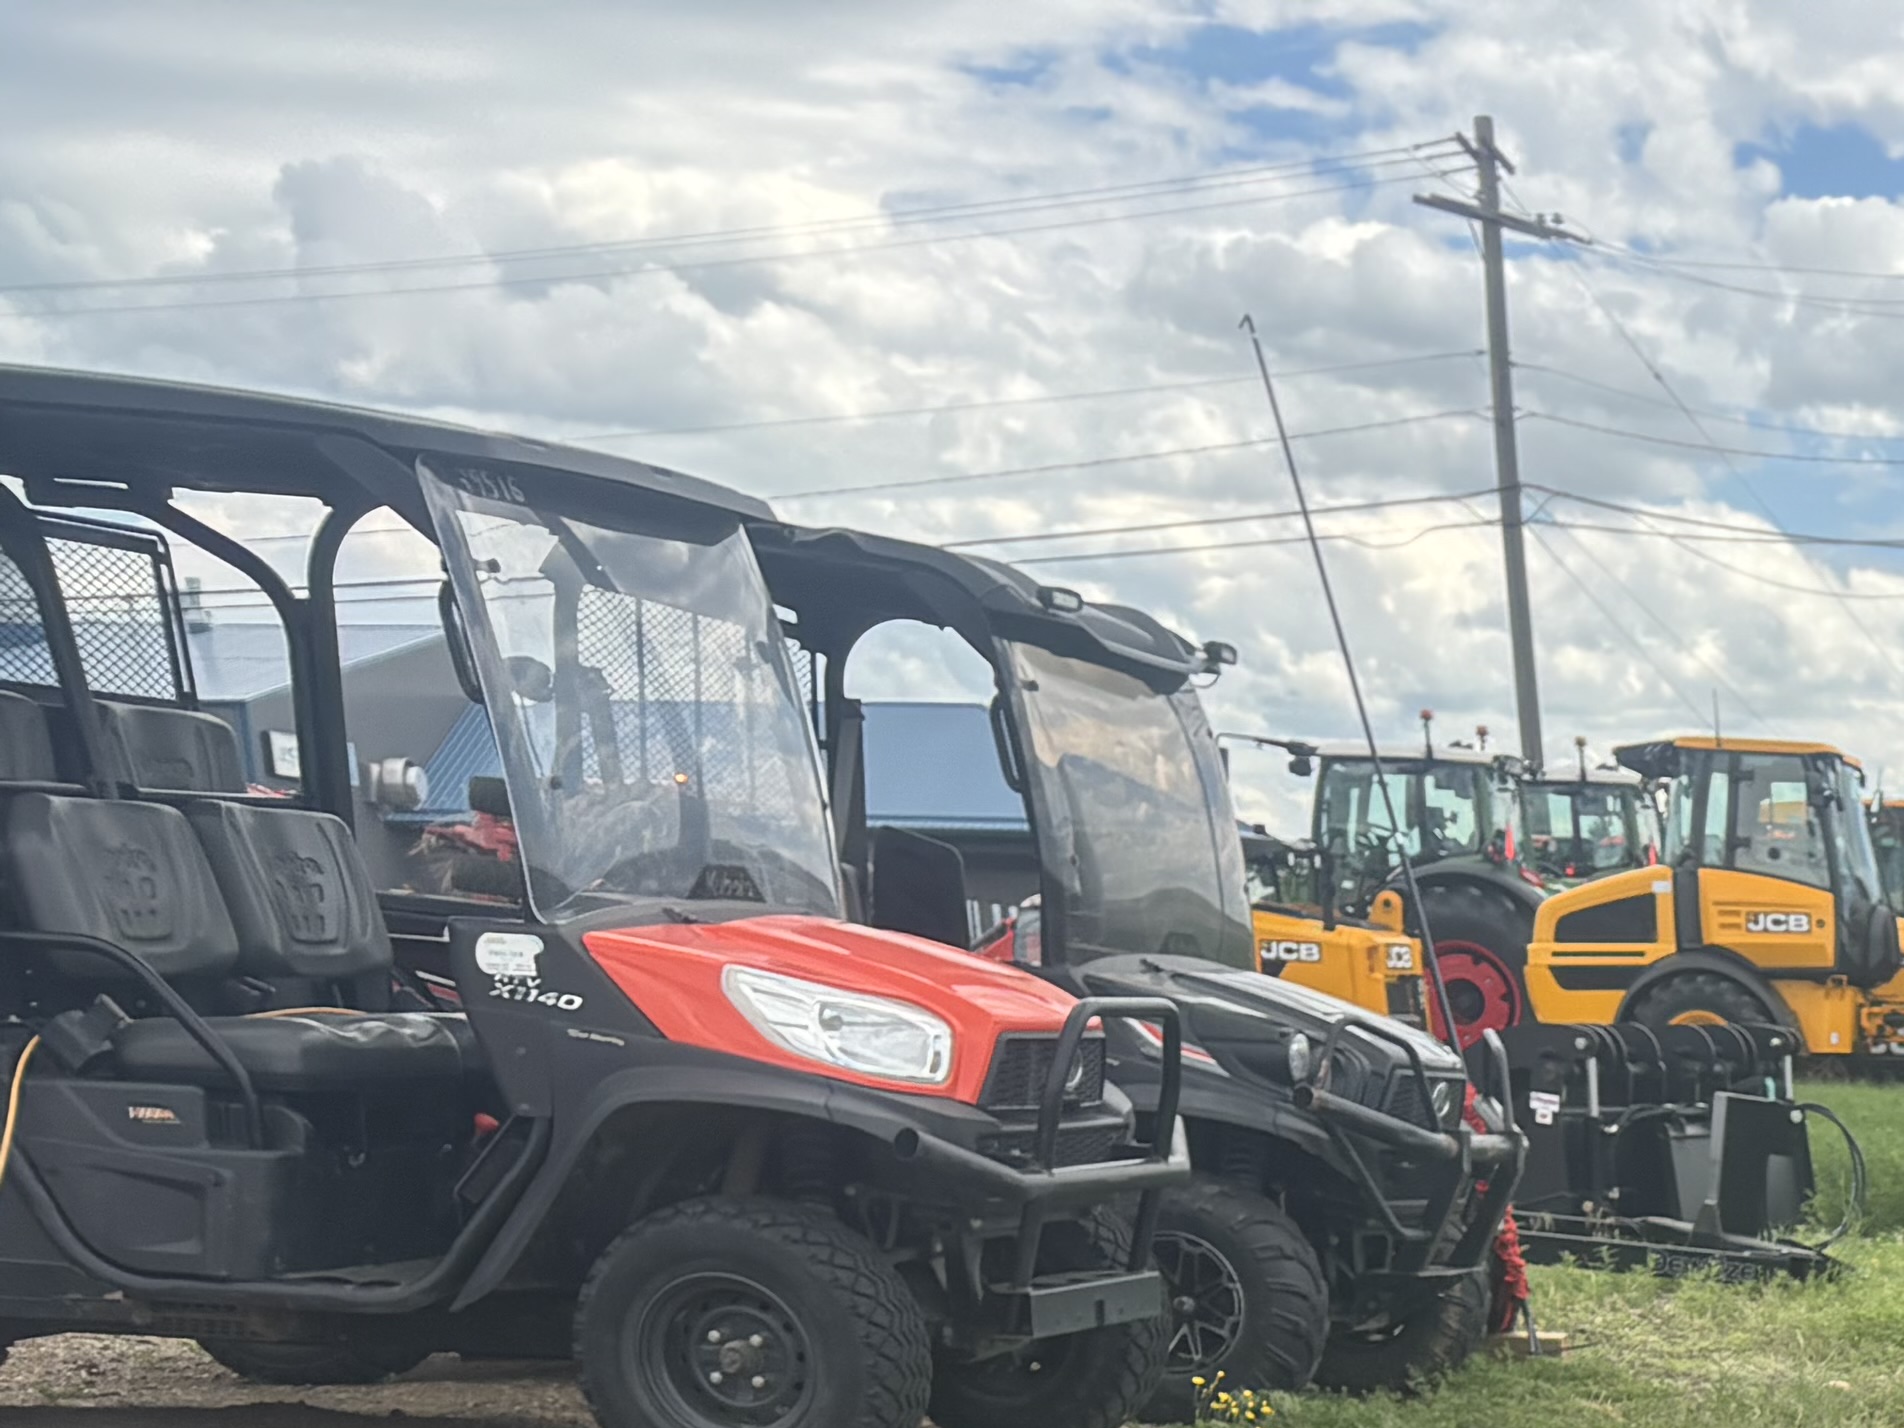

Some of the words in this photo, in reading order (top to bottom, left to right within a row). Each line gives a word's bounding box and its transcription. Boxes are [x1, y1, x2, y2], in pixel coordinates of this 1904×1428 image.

[1747, 912, 1811, 932] JCB
[1260, 940, 1321, 962] JCB
[1386, 945, 1413, 969] JCB
[488, 982, 584, 1011] X1140
